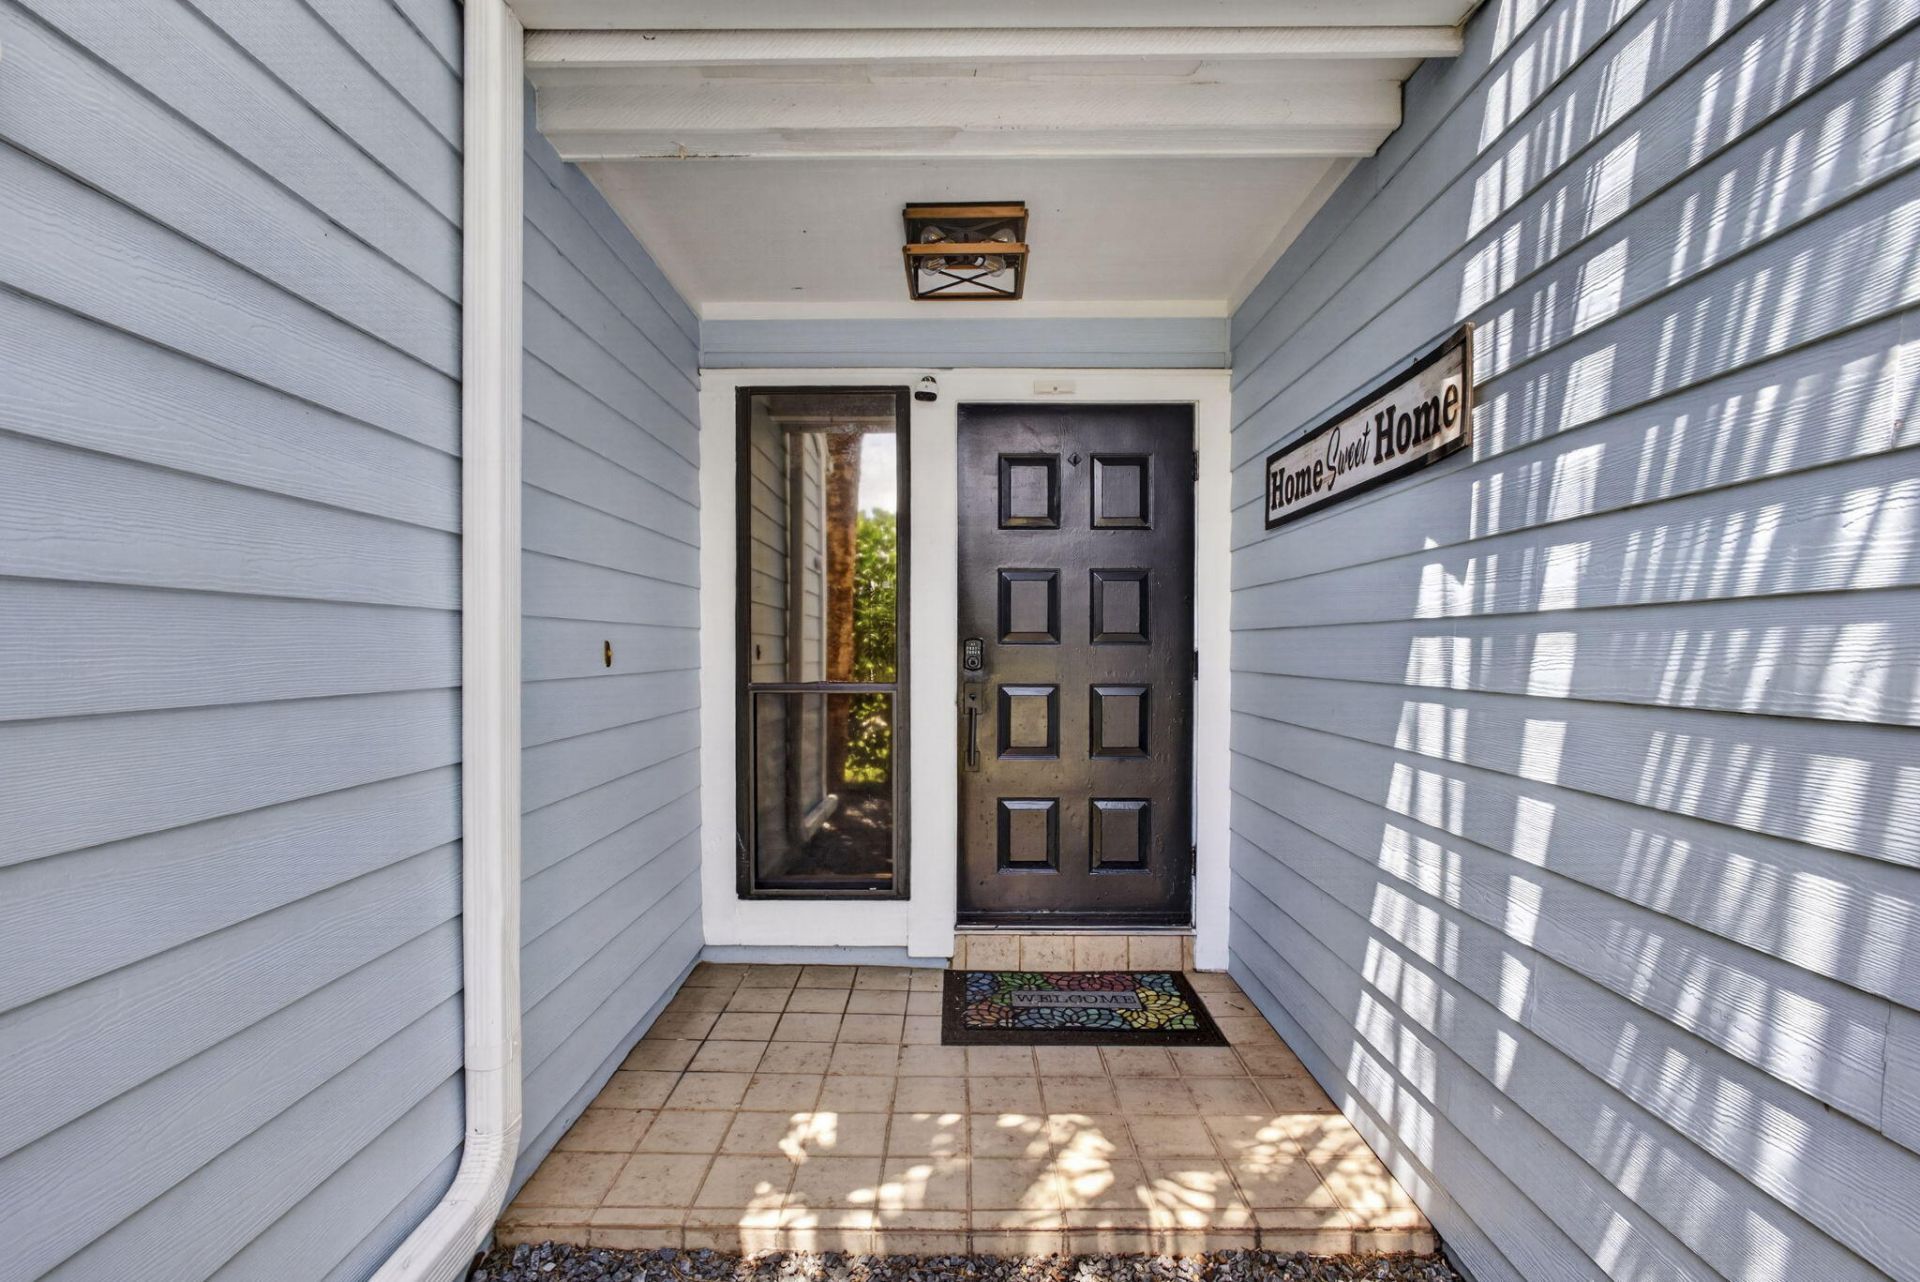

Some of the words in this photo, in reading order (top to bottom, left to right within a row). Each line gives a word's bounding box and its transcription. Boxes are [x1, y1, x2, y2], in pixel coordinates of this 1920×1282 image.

[1271, 459, 1324, 511] Home
[1326, 421, 1371, 491] Sweet
[1373, 383, 1459, 466] Home
[1016, 994, 1137, 1004] WELCOME
